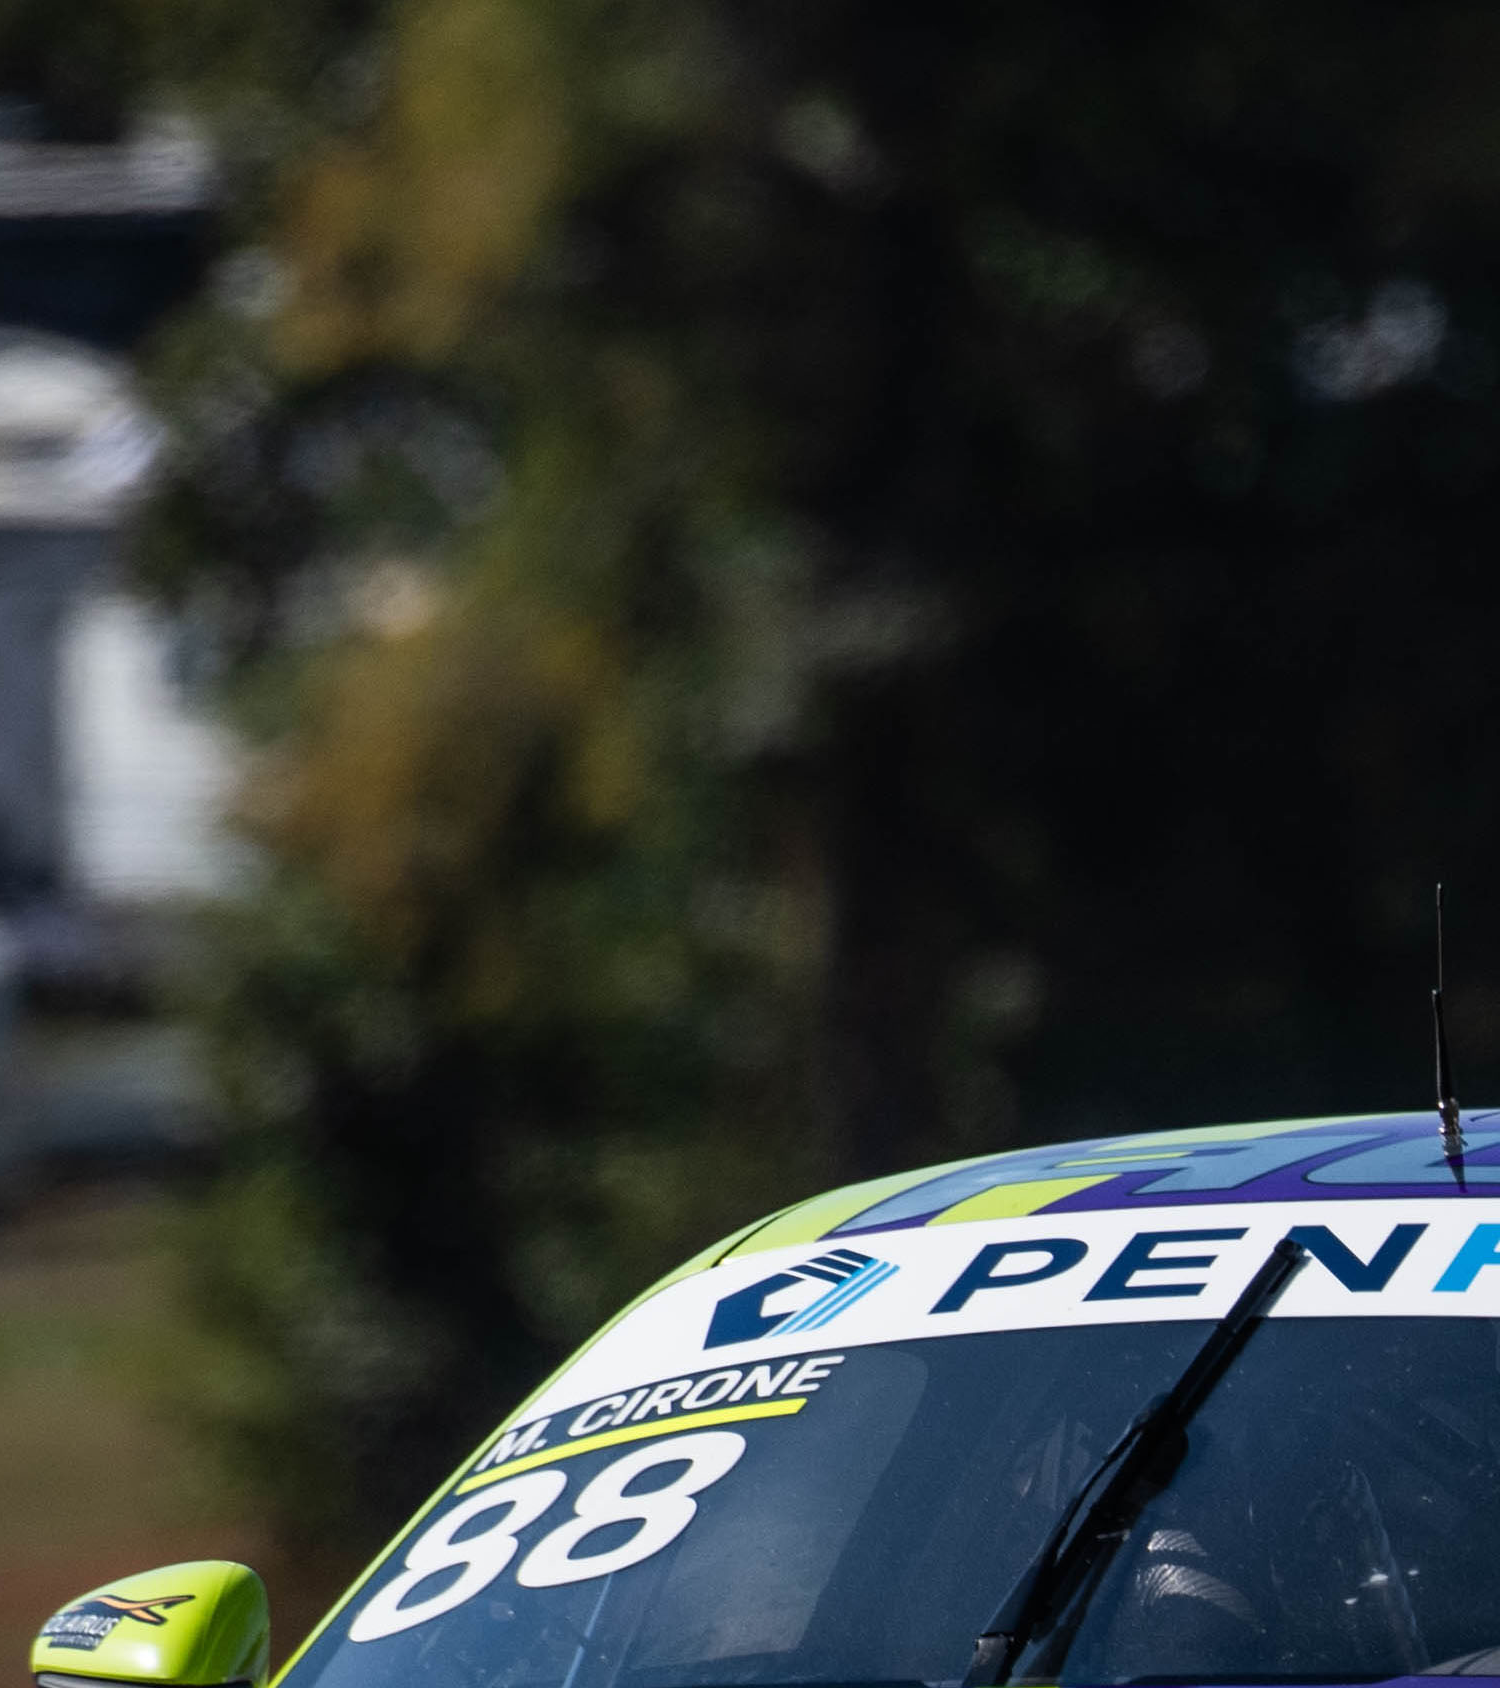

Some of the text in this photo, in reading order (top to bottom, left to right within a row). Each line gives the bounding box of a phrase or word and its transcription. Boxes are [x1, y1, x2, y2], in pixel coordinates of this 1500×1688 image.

[481, 1354, 846, 1473] M. CIRONE
[346, 1429, 748, 1644] 88
